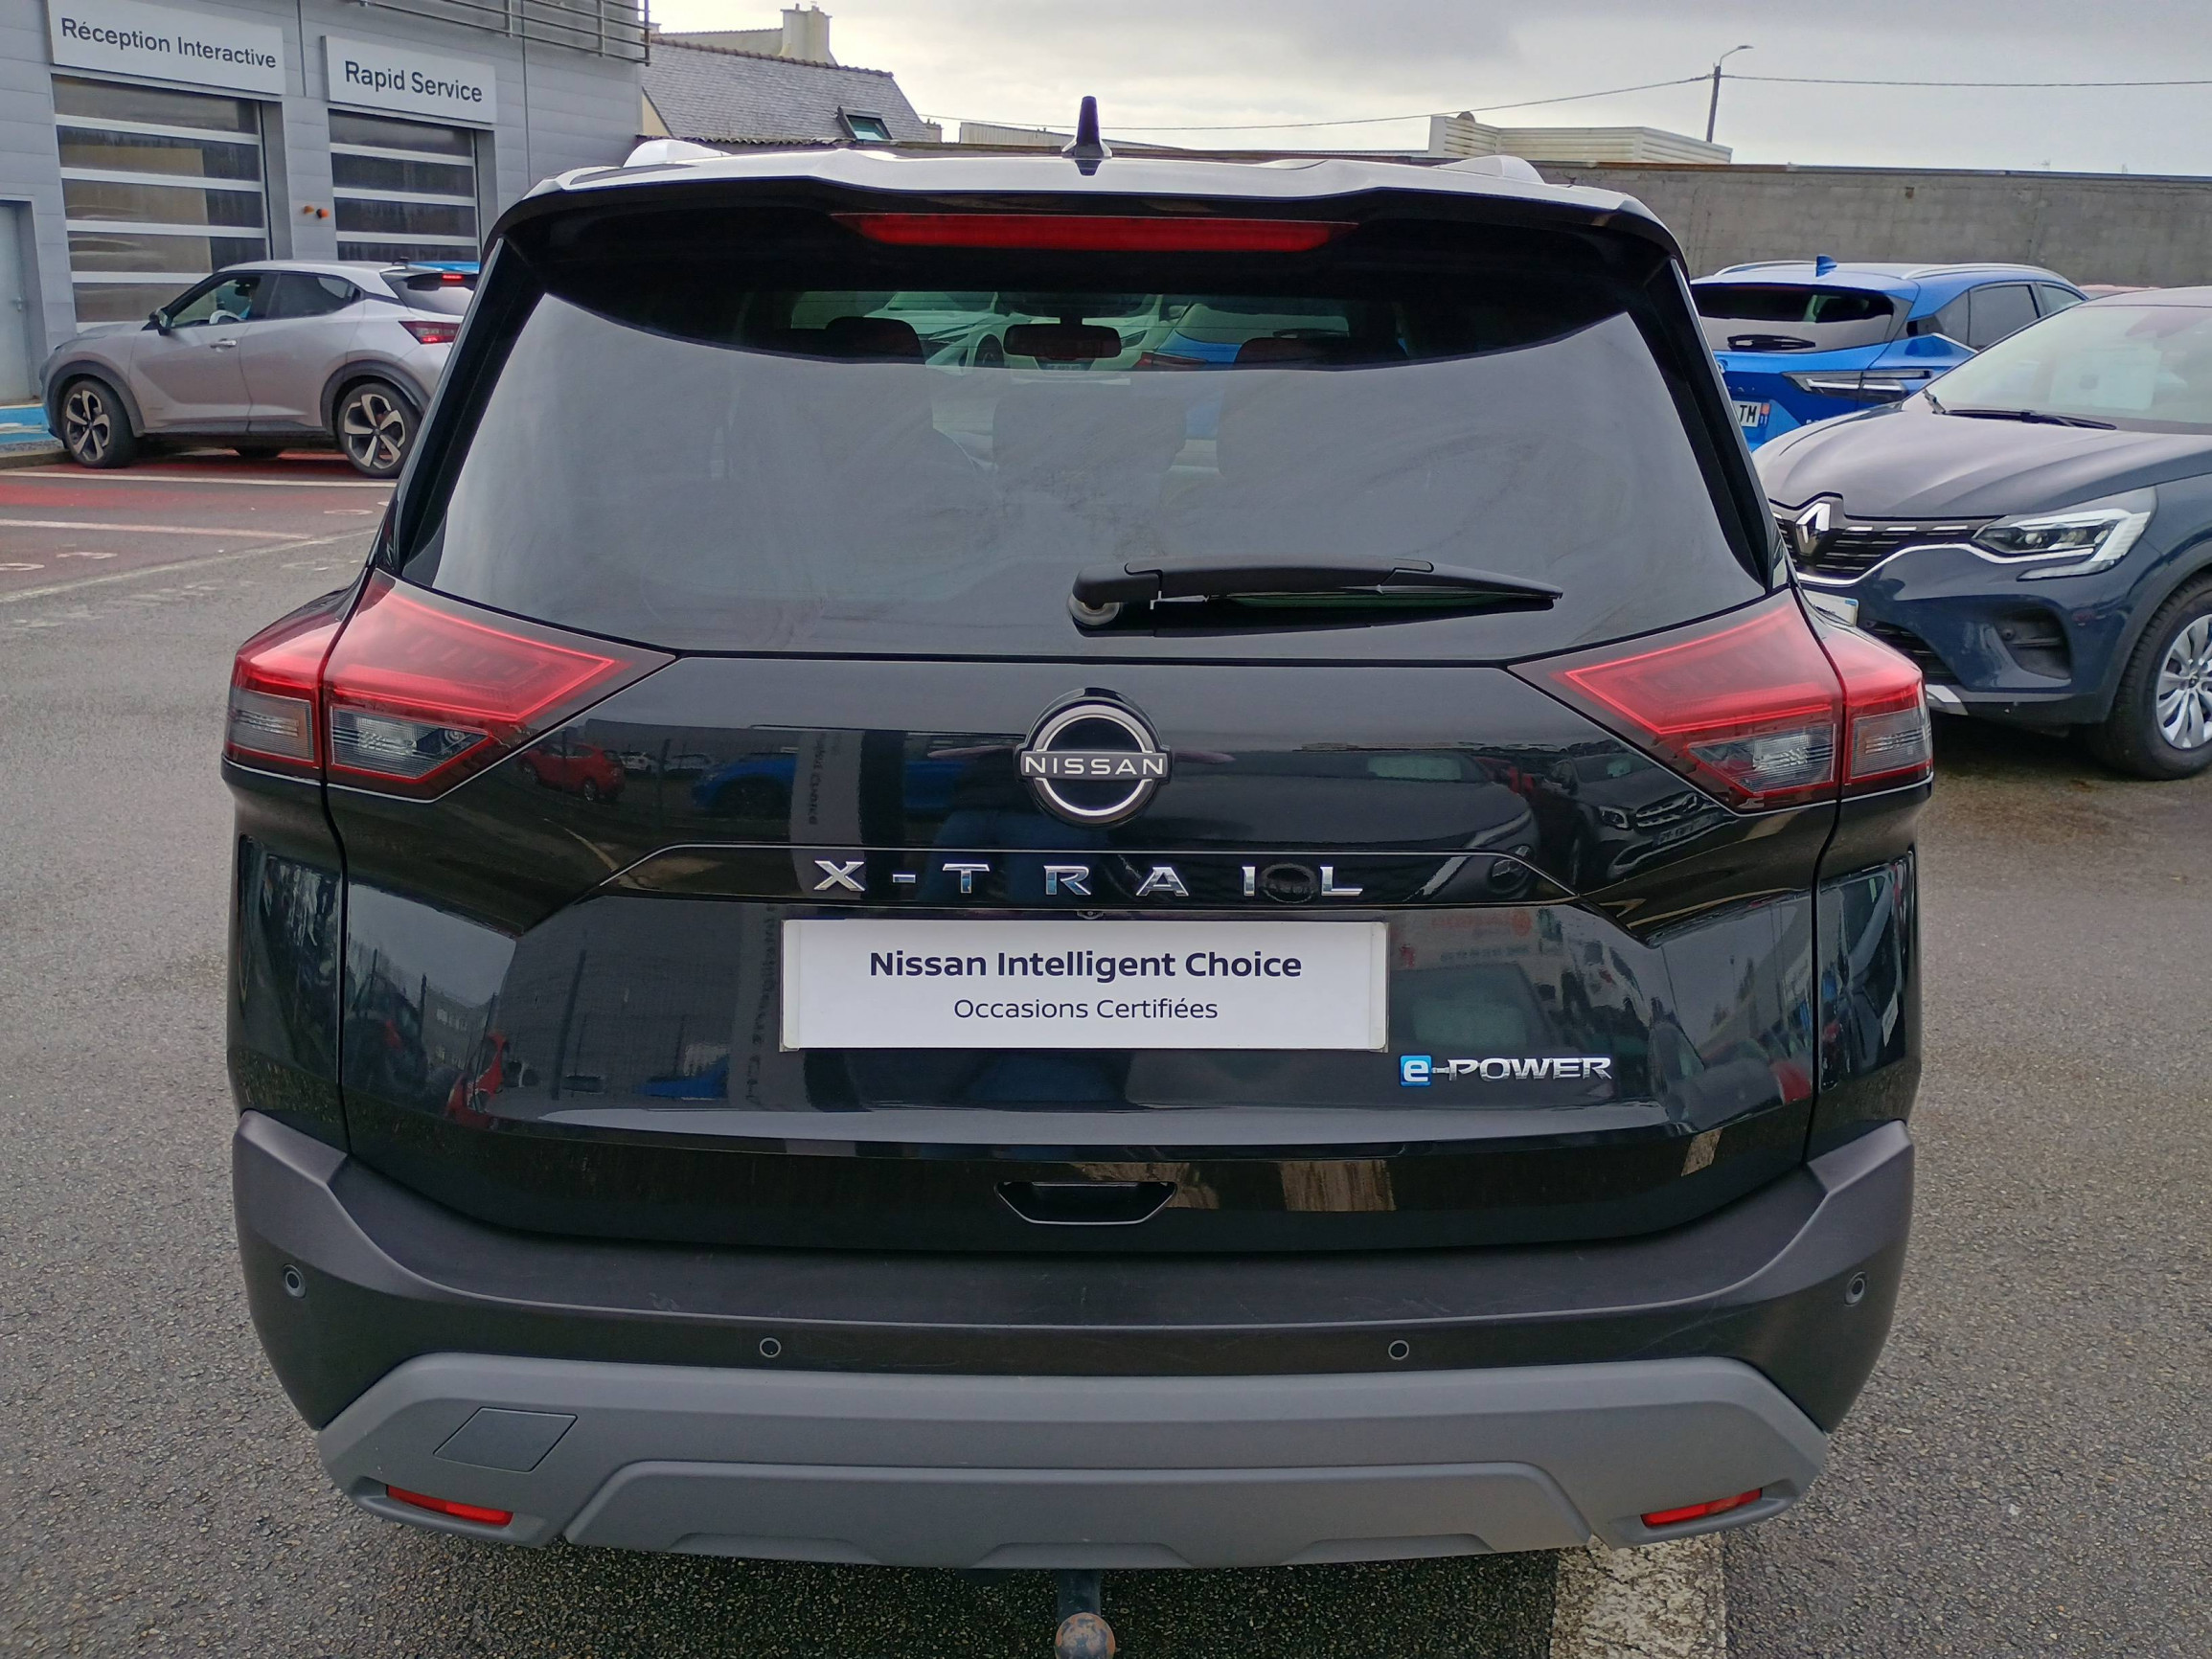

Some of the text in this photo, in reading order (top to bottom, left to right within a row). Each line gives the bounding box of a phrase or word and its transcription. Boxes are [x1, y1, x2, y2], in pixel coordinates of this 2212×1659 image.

[61, 17, 277, 69] Réception Interactive
[345, 60, 483, 102] Rapid Service
[1025, 756, 1163, 775] NISSAN
[813, 860, 1363, 897] X-TRAIL
[869, 950, 1303, 984] Nissan Intelligent Choice
[954, 998, 1219, 1019] Occasions Certifiées
[1400, 1055, 1612, 1086] e-POWER
